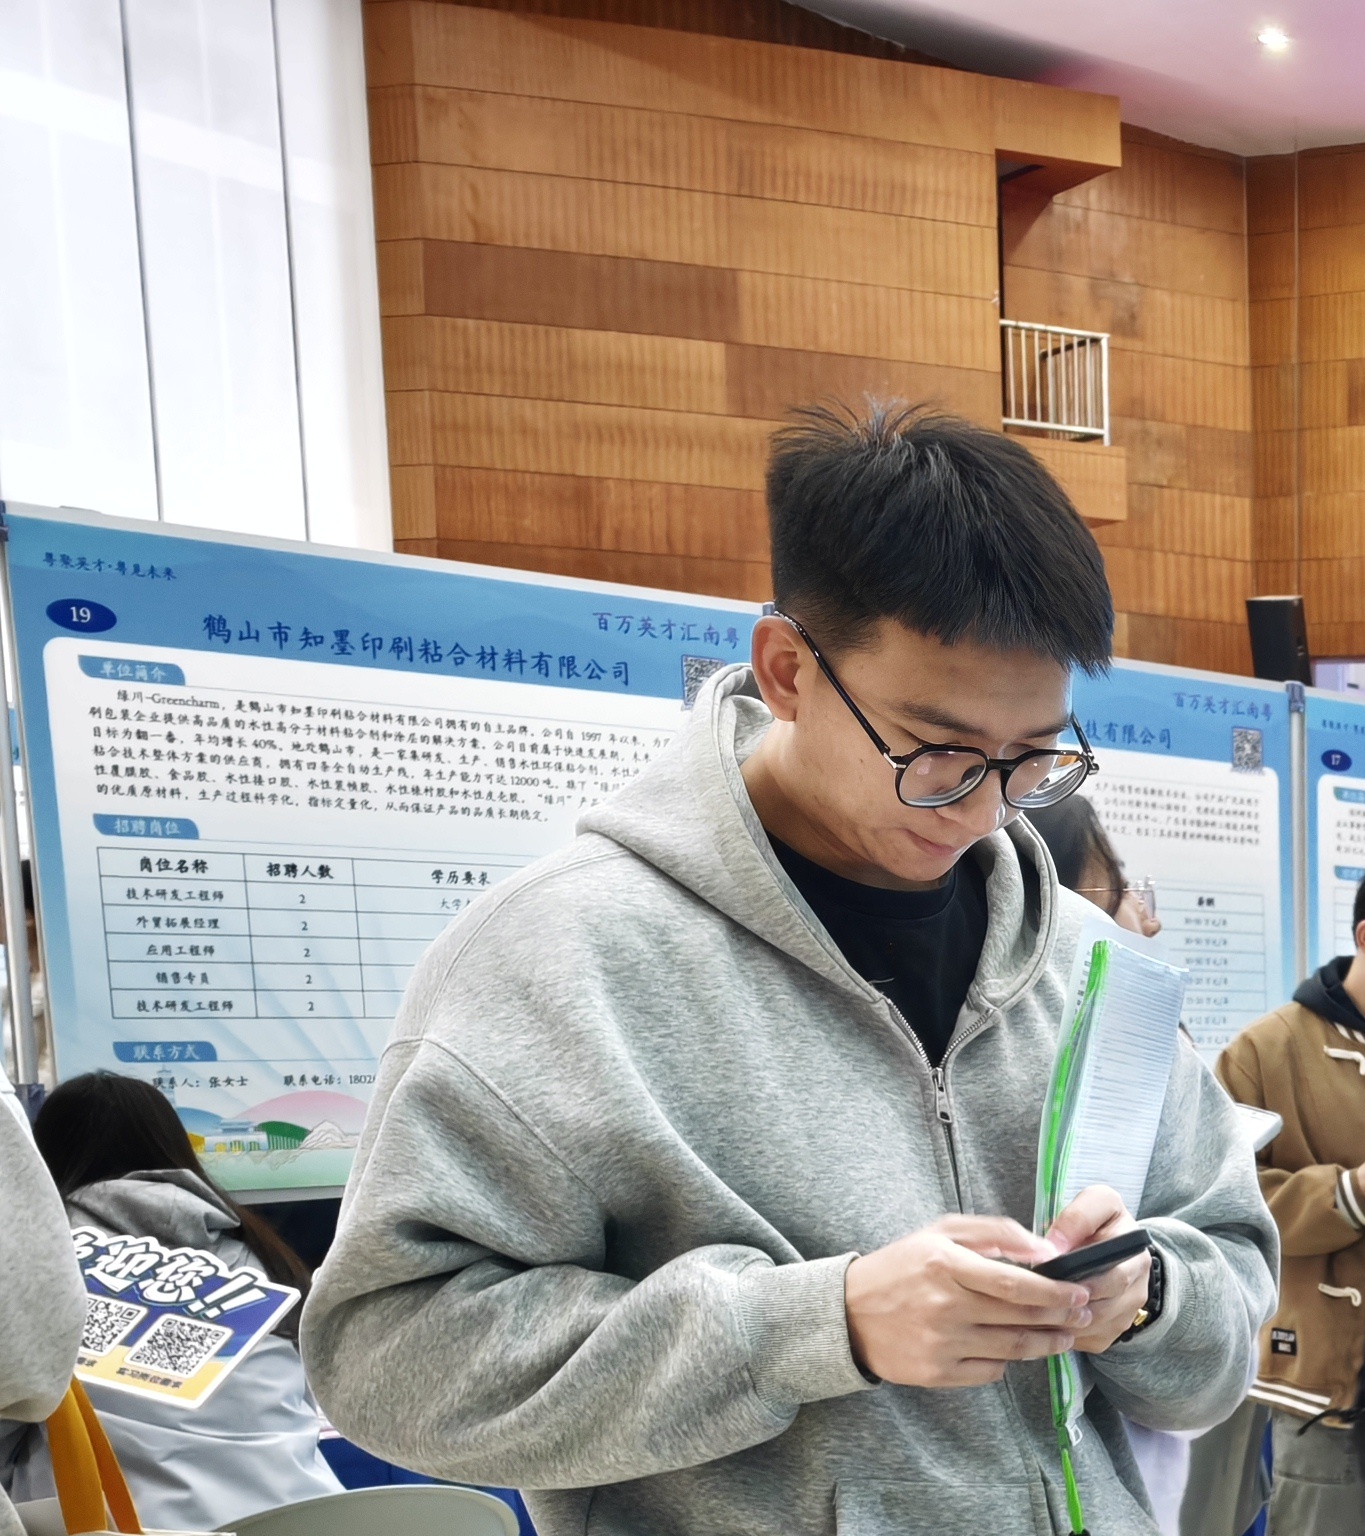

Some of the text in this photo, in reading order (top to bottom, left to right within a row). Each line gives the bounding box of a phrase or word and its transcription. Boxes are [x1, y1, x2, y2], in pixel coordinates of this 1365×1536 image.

[69, 607, 91, 623] 19
[592, 612, 741, 650] 百万英才汇南粤
[202, 613, 630, 686] 鹤山市知墨印刷粘合材料有限公司
[99, 660, 167, 683] 单位简介
[1173, 692, 1273, 722] 百万英才汇南粤
[582, 731, 602, 742] 1997
[1331, 754, 1341, 766] 17
[510, 774, 540, 788] 12000
[114, 816, 181, 836] 招聘岗位
[139, 856, 491, 886] 岗位名称 招聘人数 学历要求
[125, 887, 471, 911] 技术研发工程师 2 大学
[135, 916, 308, 931] 外贸拓展经理 2
[146, 943, 310, 958] 应用工程师 2
[155, 971, 312, 985] 销售专员 2
[136, 999, 314, 1013] 技术研发工程师 2
[133, 1044, 200, 1060] 联系方式
